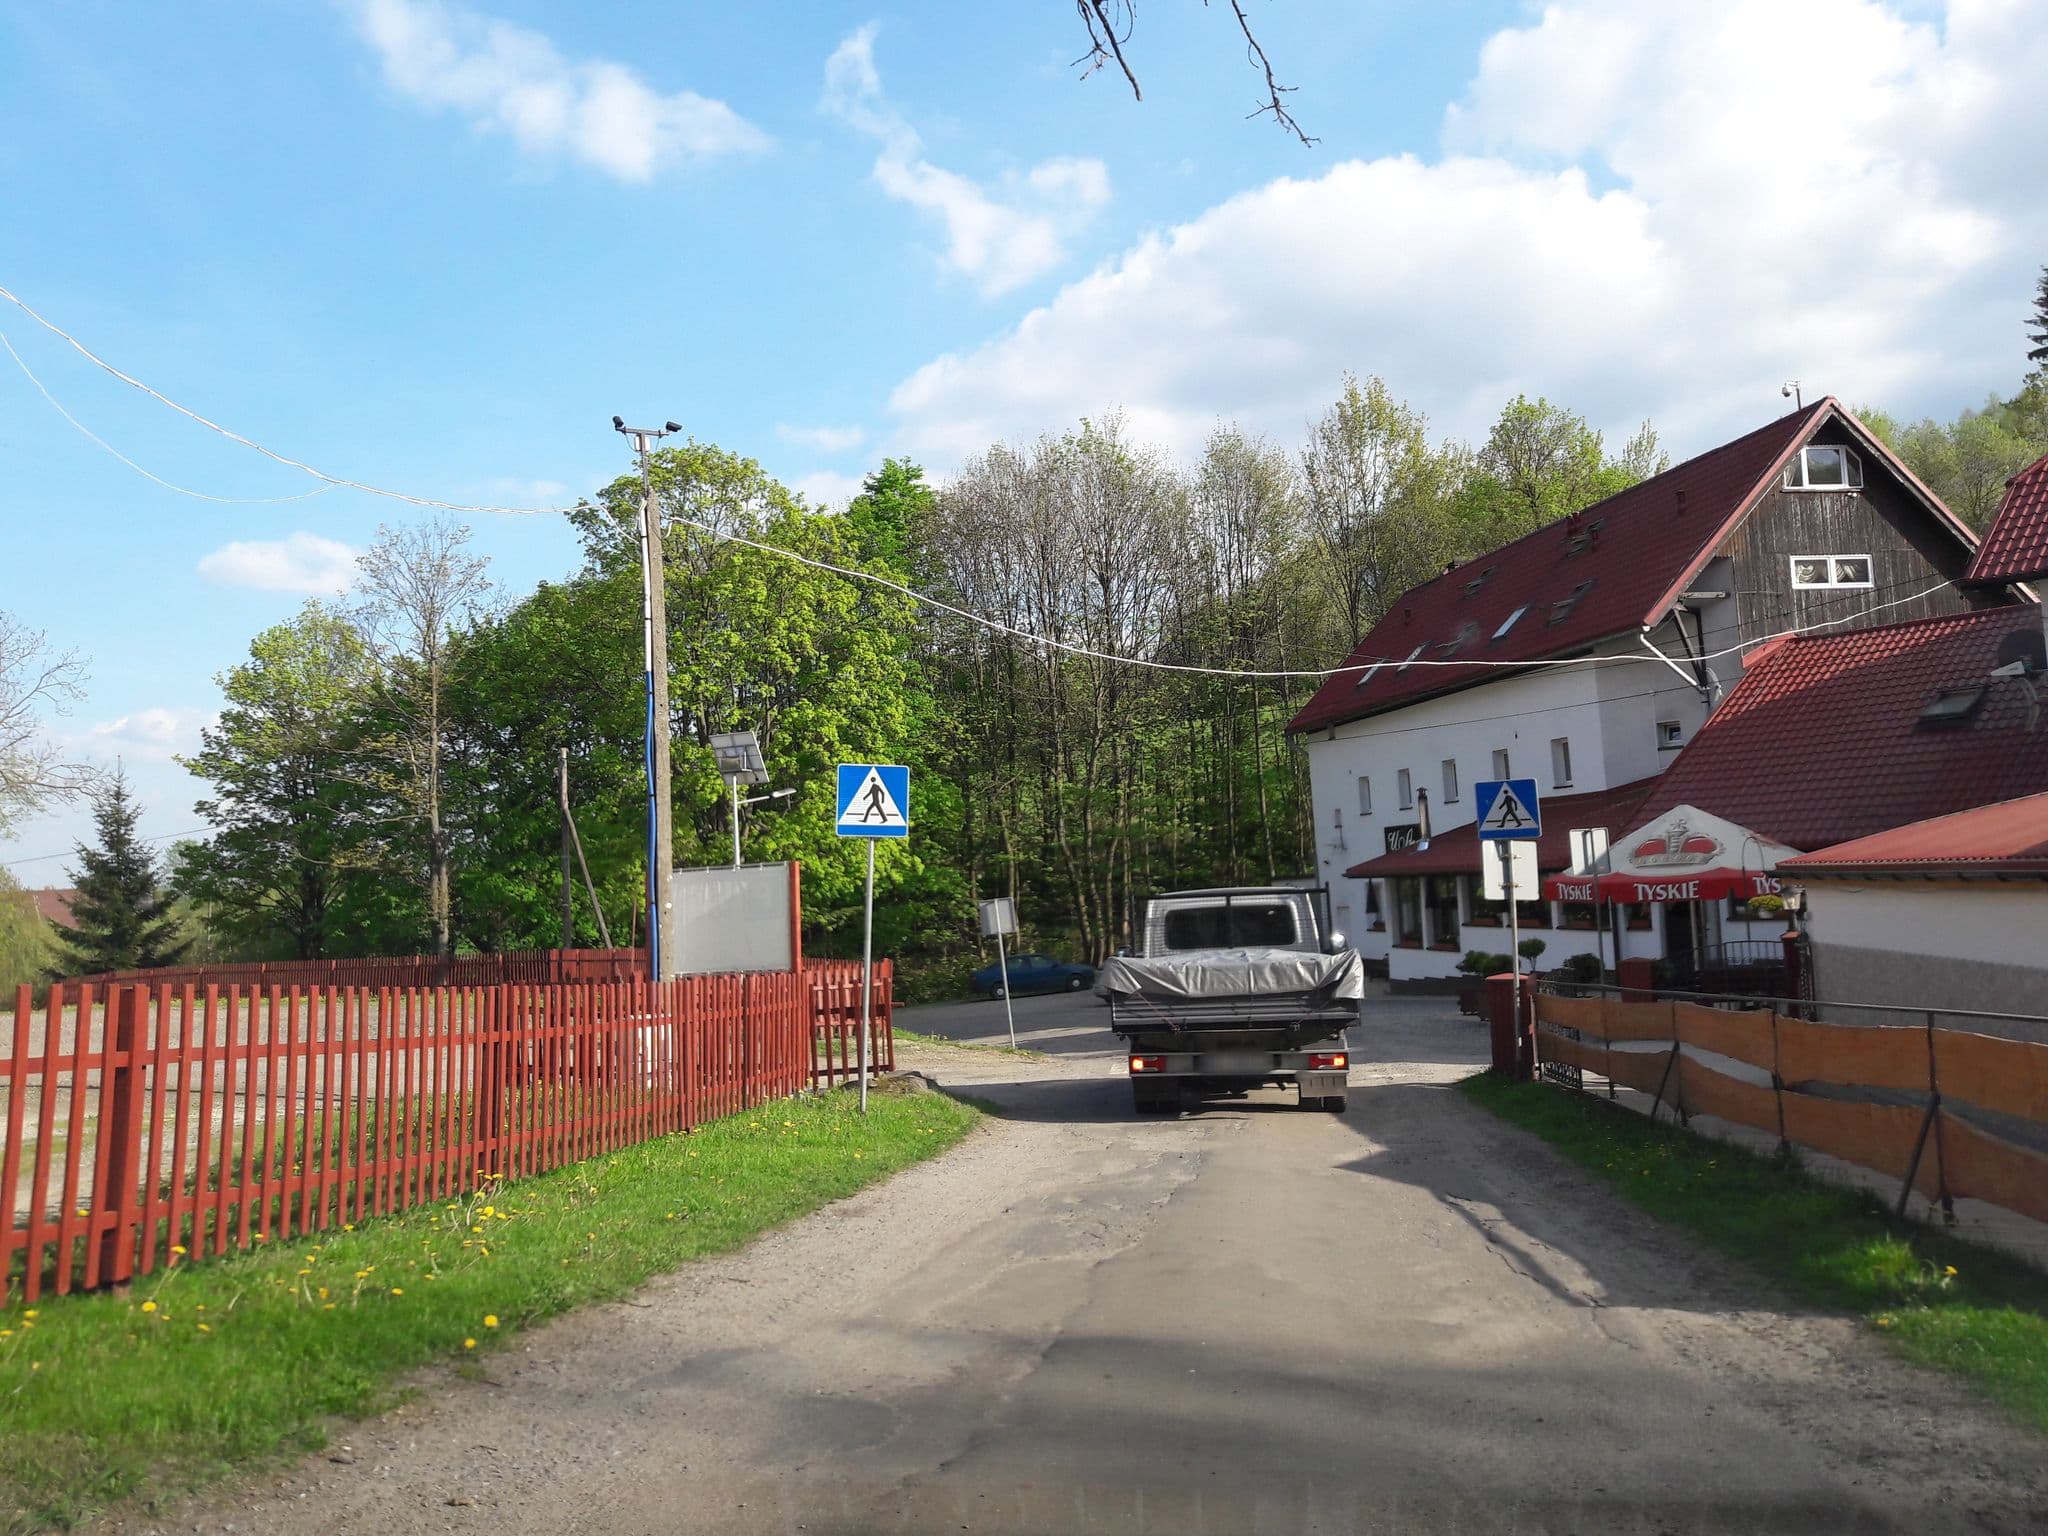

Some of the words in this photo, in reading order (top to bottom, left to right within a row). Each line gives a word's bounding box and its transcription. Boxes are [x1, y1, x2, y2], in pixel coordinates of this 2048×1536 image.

[1556, 882, 1593, 900] TYSKIE
[1633, 880, 1700, 901] TYSKIE
[1752, 876, 1781, 895] TYS
